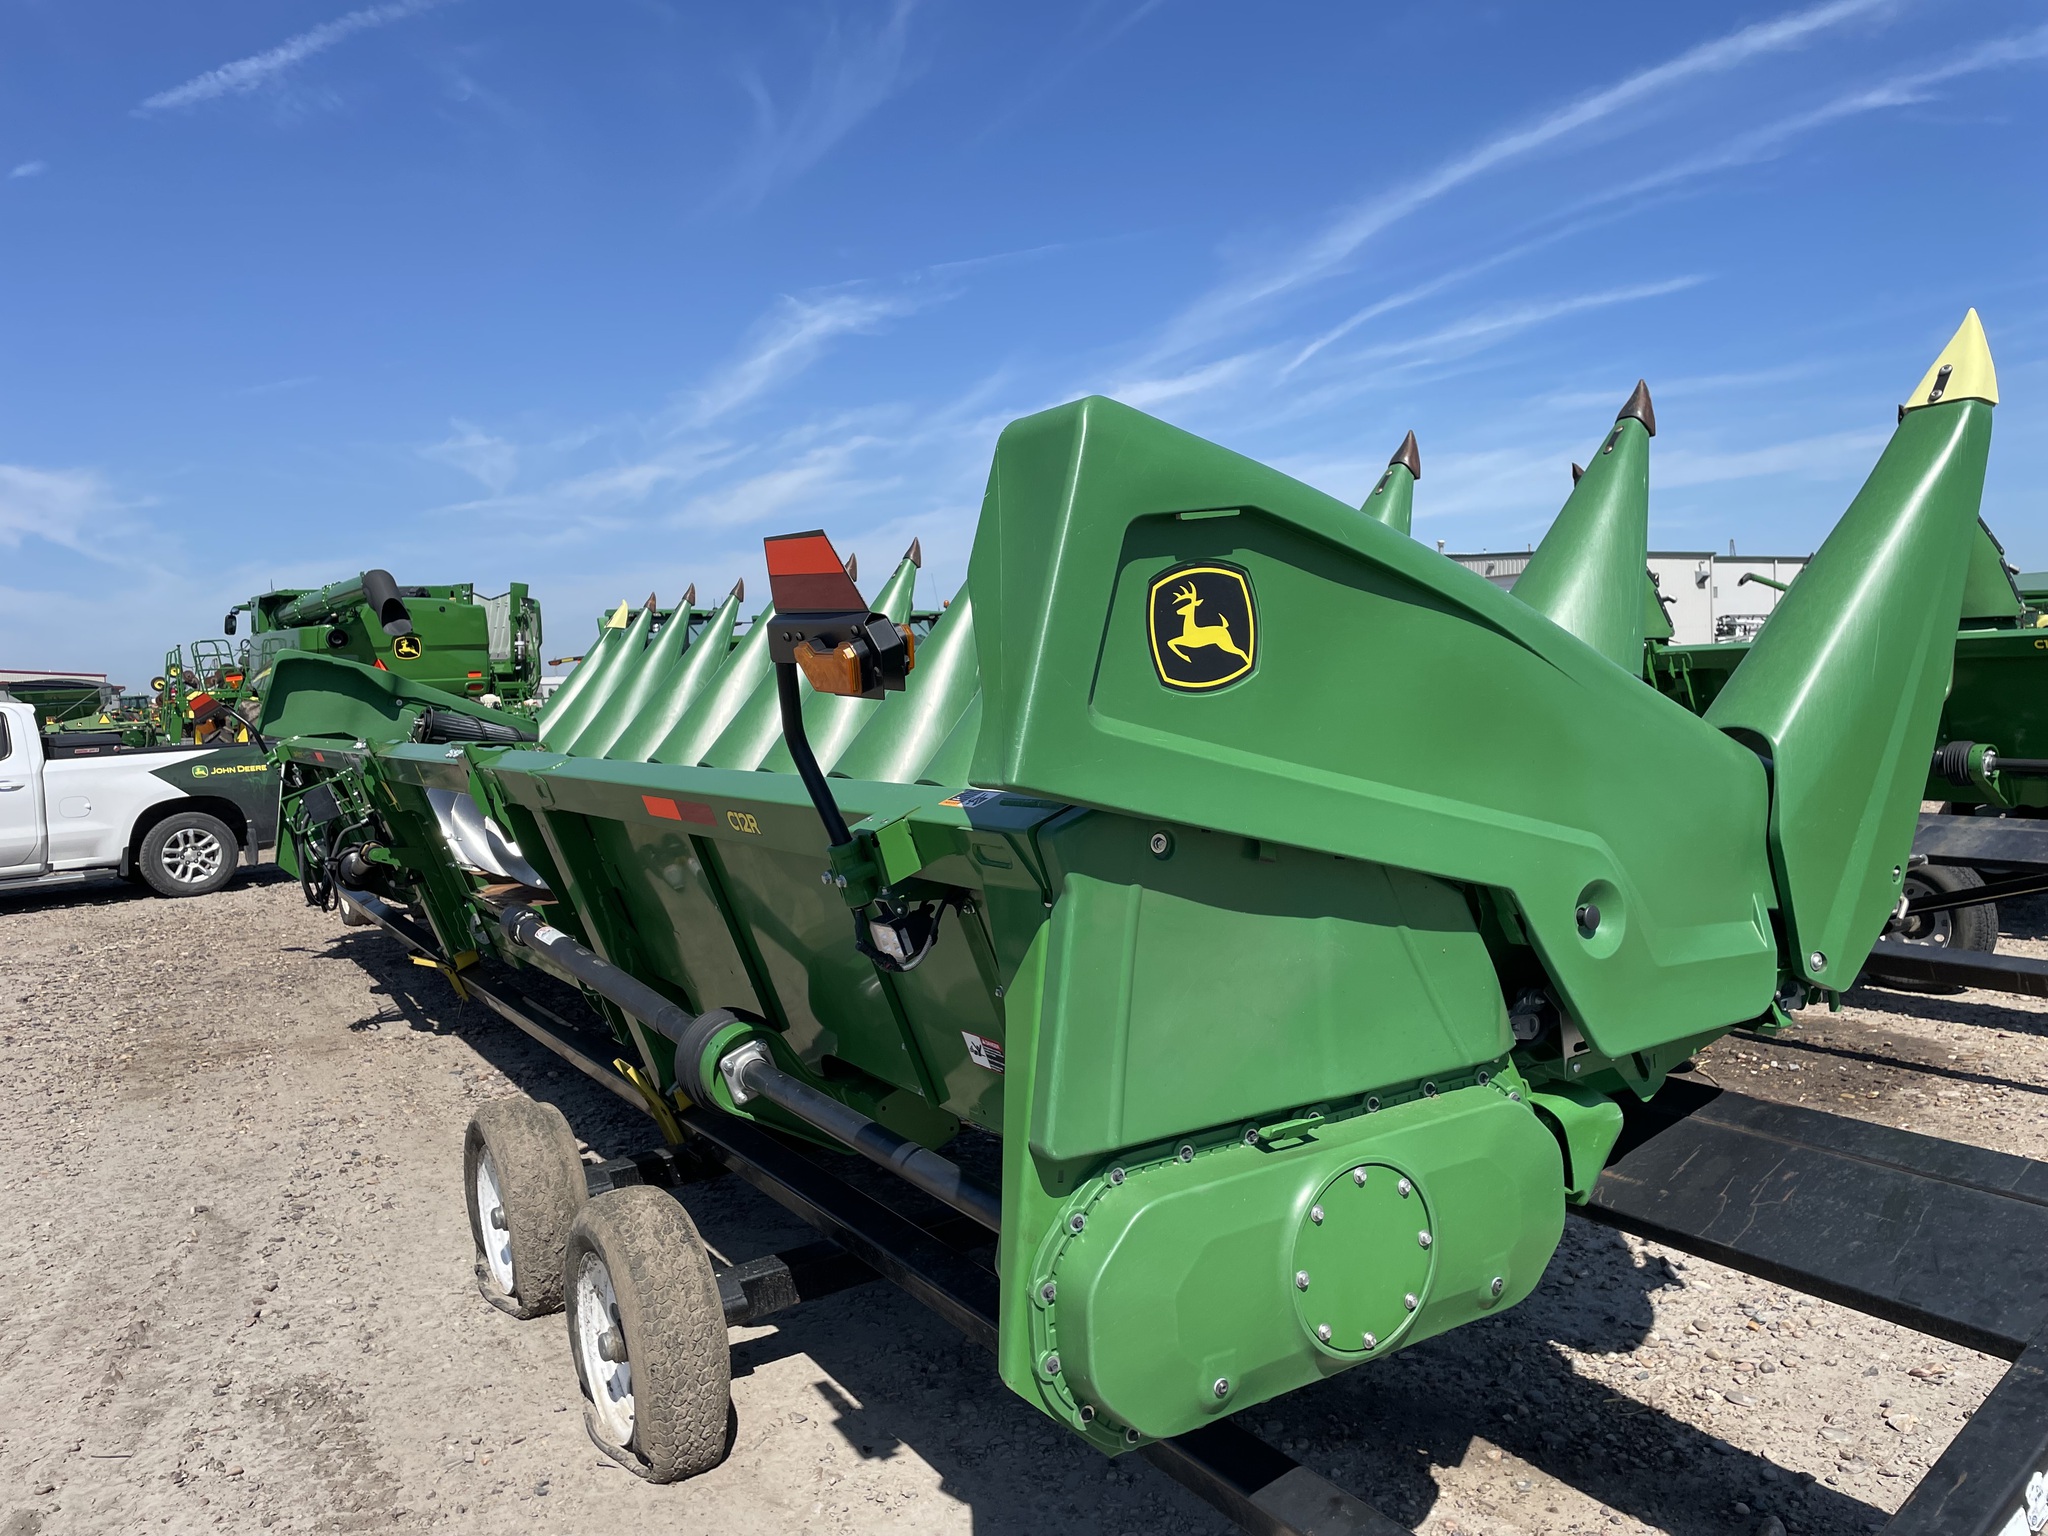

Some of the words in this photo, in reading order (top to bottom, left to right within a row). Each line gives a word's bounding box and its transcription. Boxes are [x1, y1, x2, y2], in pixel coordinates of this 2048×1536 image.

[211, 766, 236, 775] JOHN
[237, 764, 267, 773] DEERE
[726, 810, 762, 835] C12R
